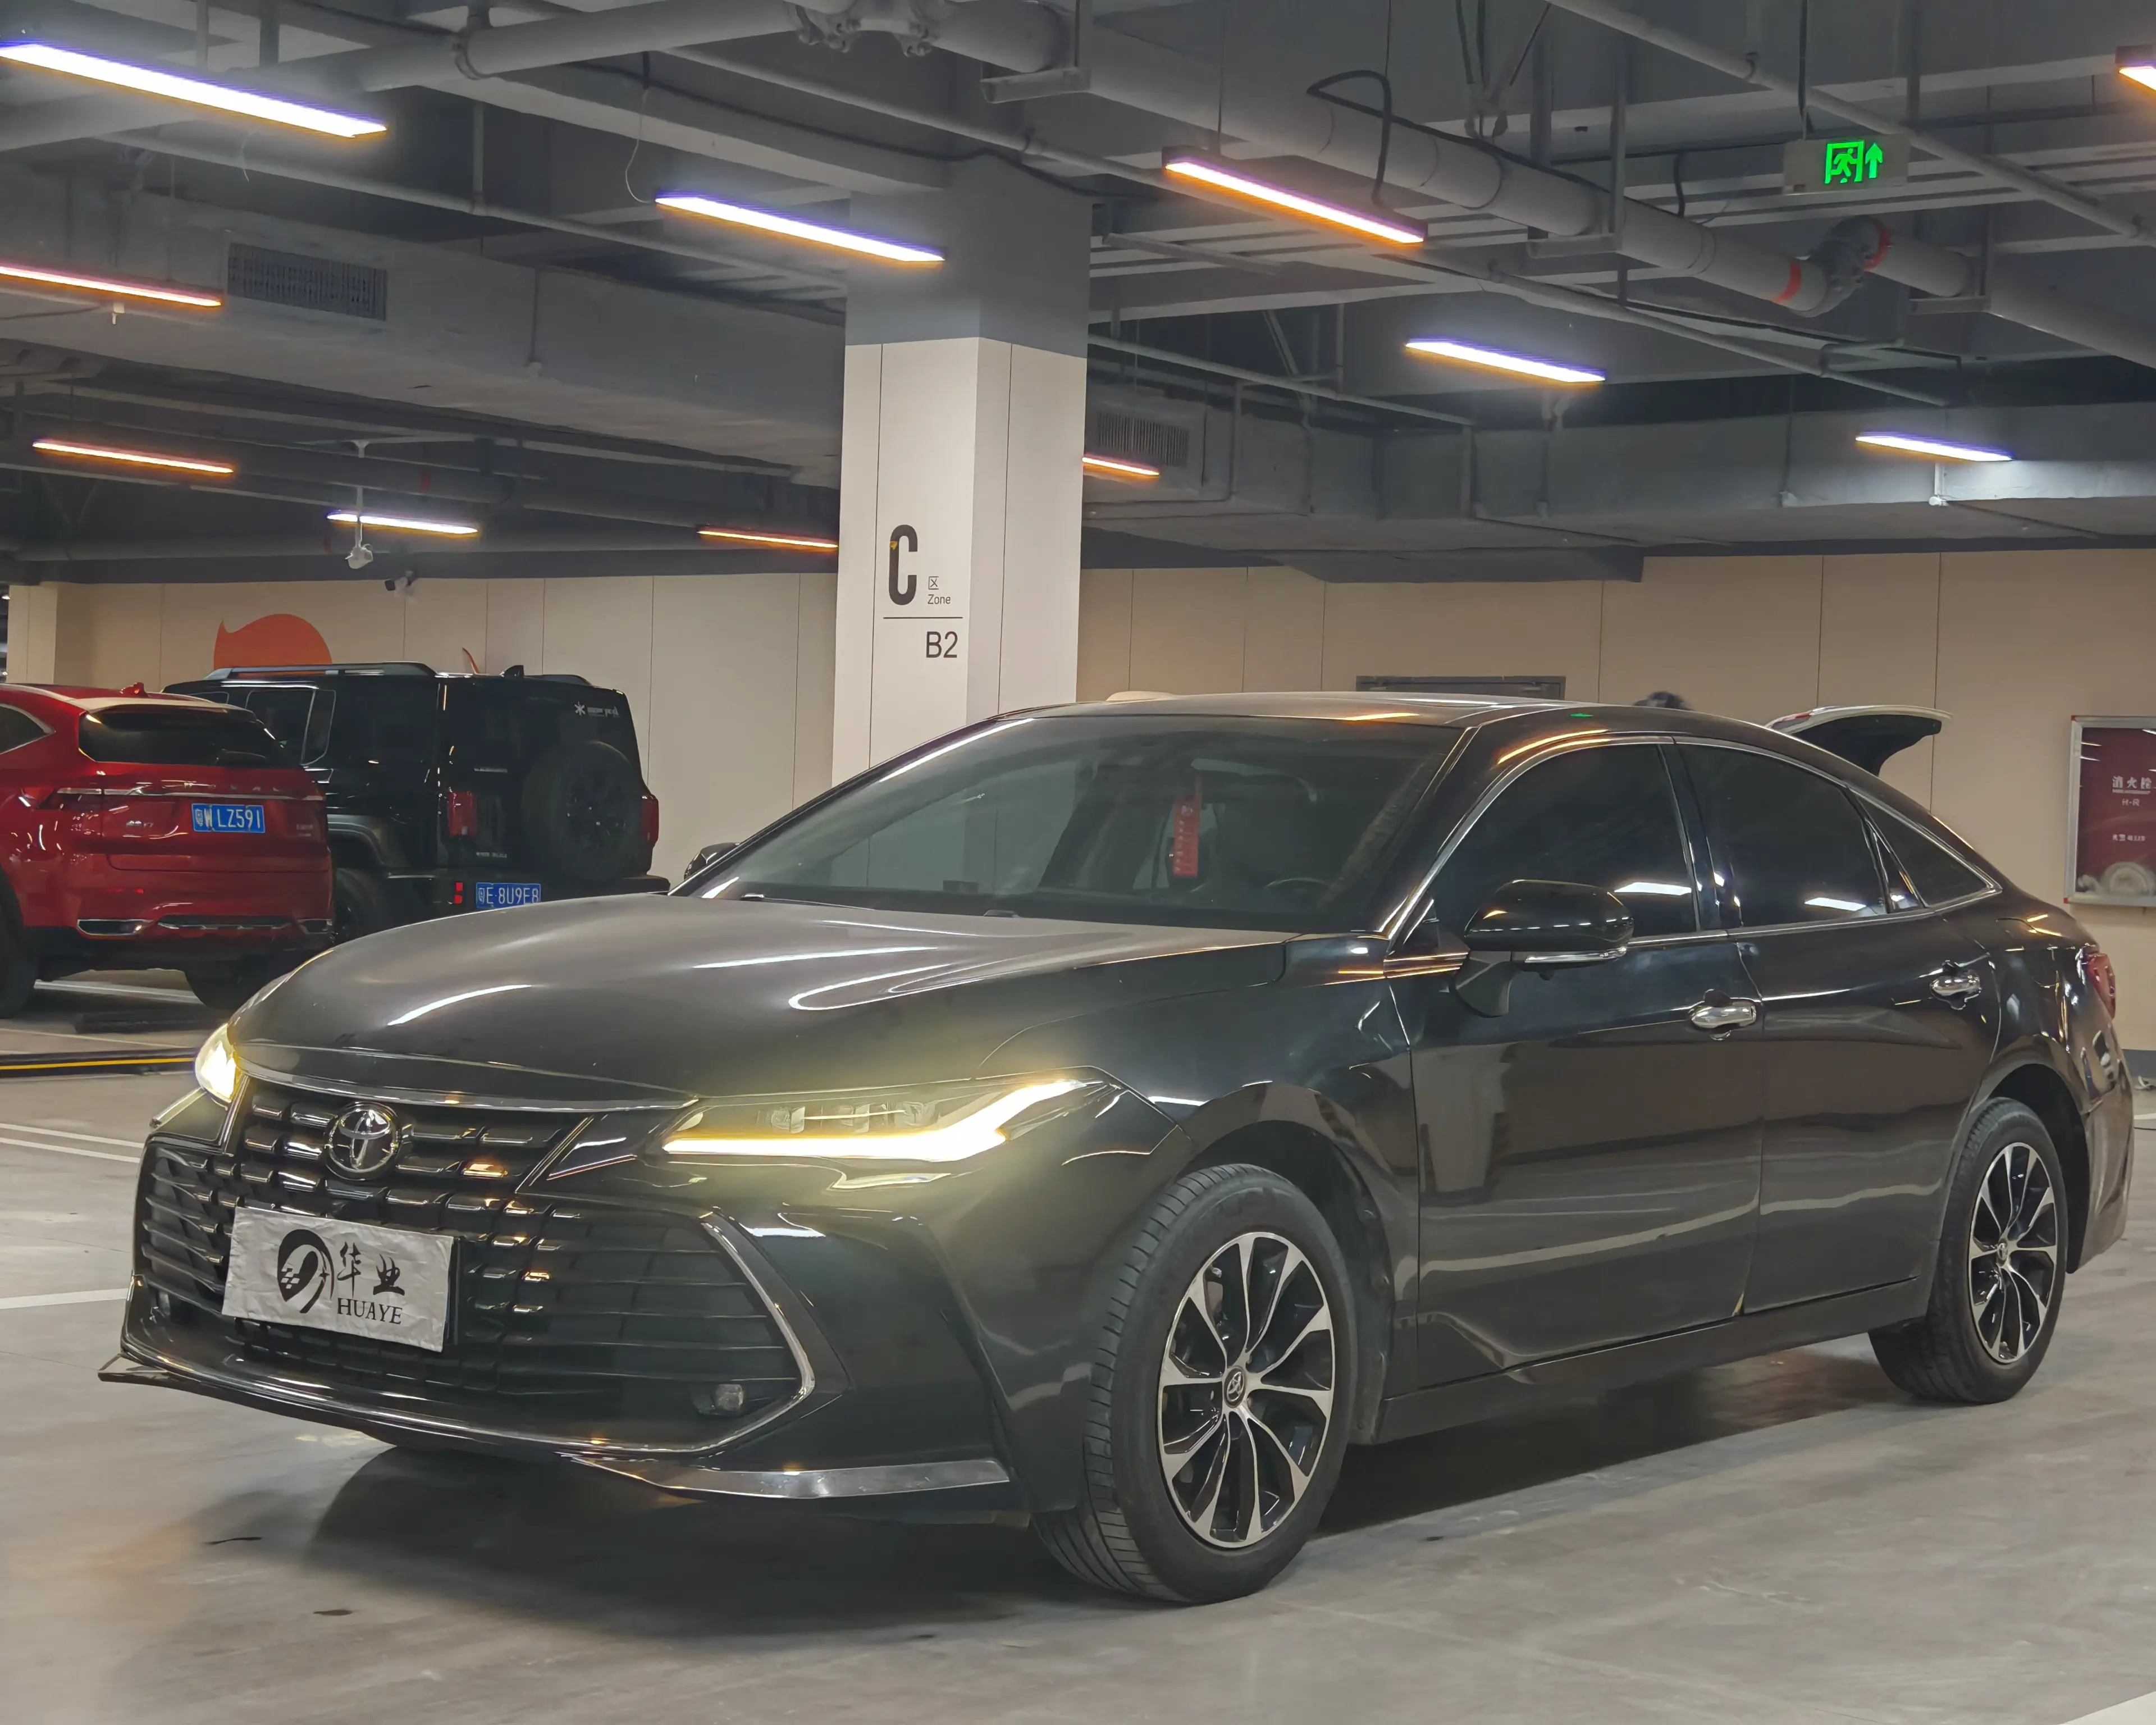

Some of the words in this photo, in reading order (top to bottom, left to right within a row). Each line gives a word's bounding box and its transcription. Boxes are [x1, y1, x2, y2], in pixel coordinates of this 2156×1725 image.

[889, 524, 918, 606] C
[928, 576, 939, 590] 区
[928, 594, 951, 605] Zone
[926, 631, 958, 658] B2
[337, 1241, 405, 1297] 华业
[337, 1298, 403, 1325] HUAYE
